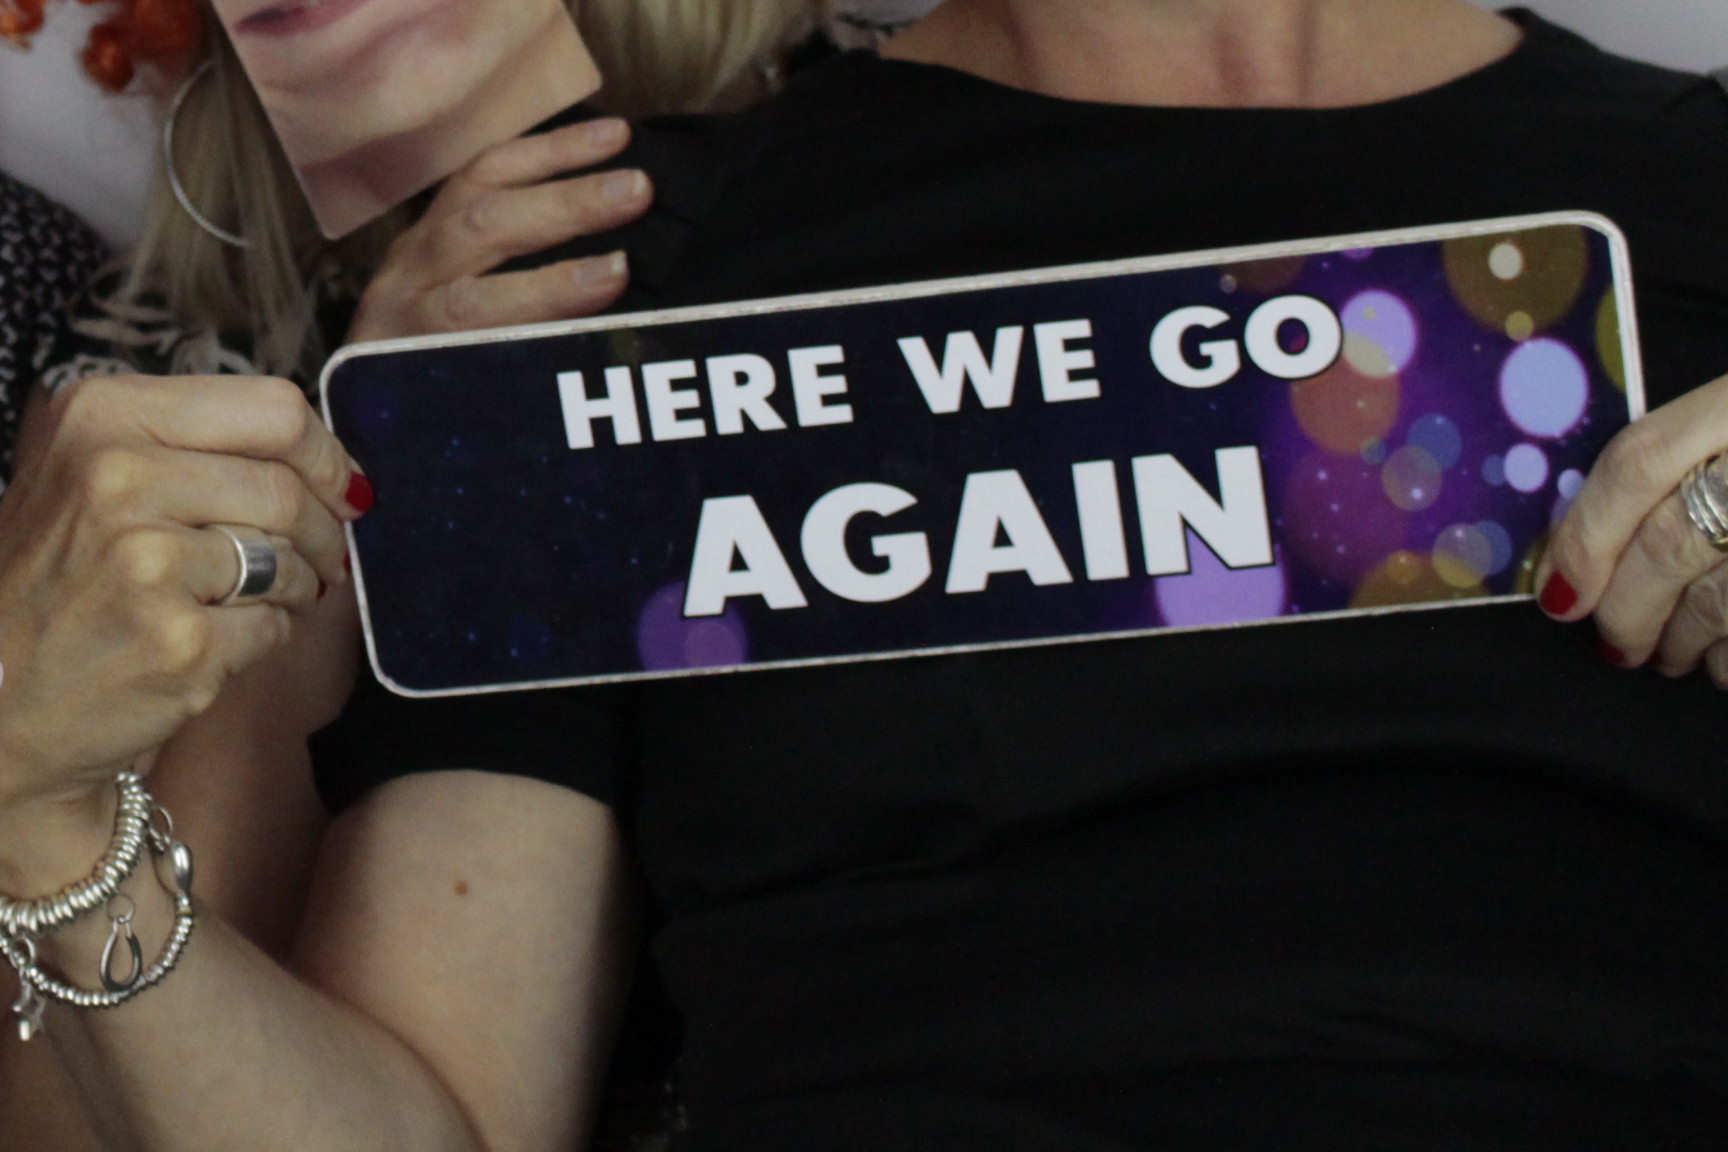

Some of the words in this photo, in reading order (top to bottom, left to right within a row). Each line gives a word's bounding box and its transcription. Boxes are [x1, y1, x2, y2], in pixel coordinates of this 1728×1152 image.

[556, 343, 854, 450] HERE
[897, 318, 1101, 415] WE
[1149, 294, 1342, 390] GO
[683, 445, 1274, 618] AGAIN
